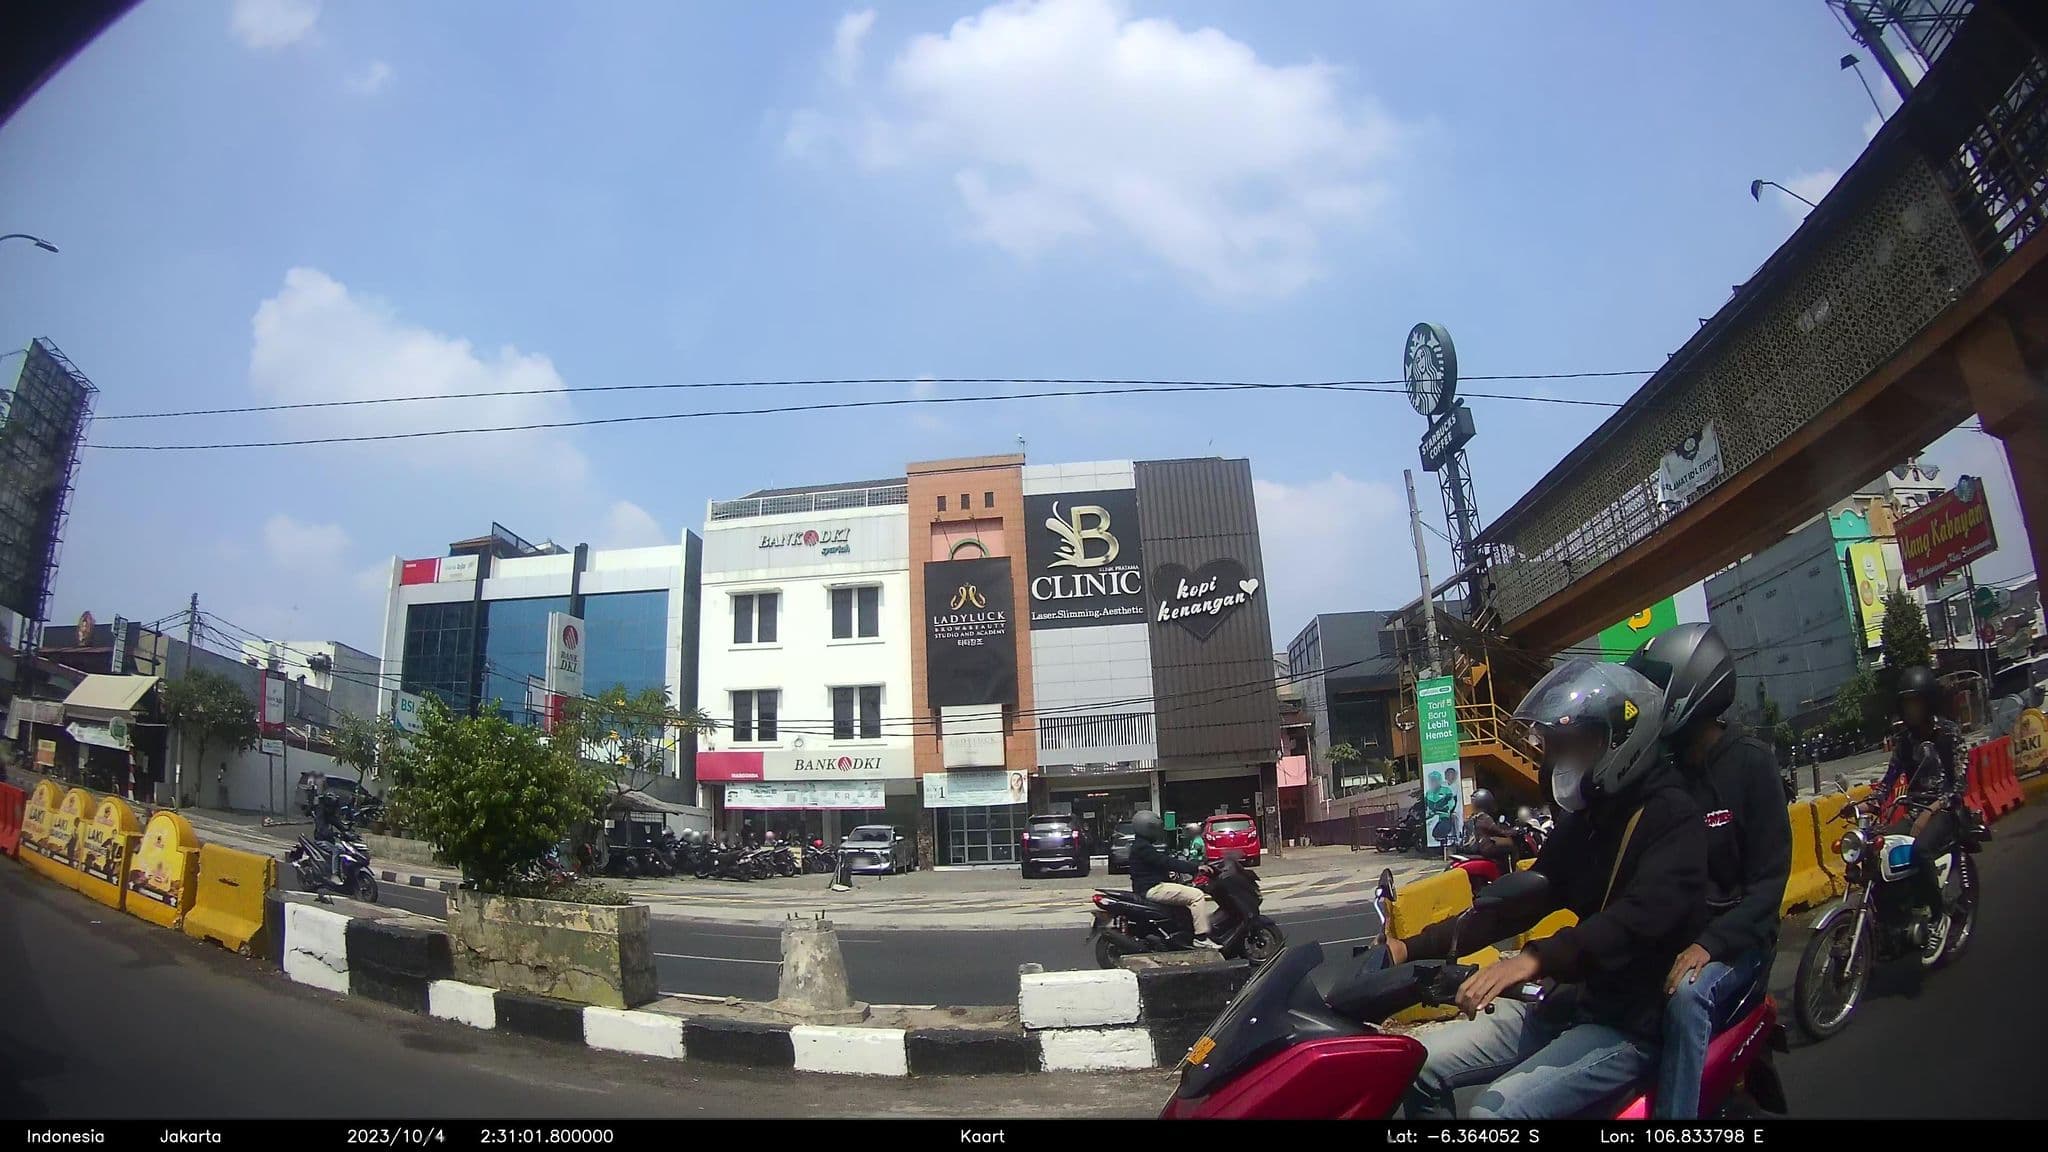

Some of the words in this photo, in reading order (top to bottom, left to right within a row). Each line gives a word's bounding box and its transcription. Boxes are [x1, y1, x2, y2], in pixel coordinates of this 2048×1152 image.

[1422, 413, 1456, 455] STARBUCKS
[1430, 431, 1452, 459] COFFEE
[1930, 504, 1984, 547] Kabayan
[759, 532, 804, 548] BANK
[819, 528, 851, 543] DKI
[1031, 570, 1142, 601] CLINIC
[1176, 576, 1217, 599] kopi
[1157, 592, 1246, 622] kenangan
[933, 610, 1006, 625] LADYLUCK
[960, 630, 975, 638] AND
[560, 660, 578, 674] DKI
[1427, 719, 1449, 730] Lebih
[1428, 711, 1447, 721] Baru
[1425, 729, 1453, 740] Hemat
[794, 757, 837, 771] BANK
[852, 757, 882, 770] DKI
